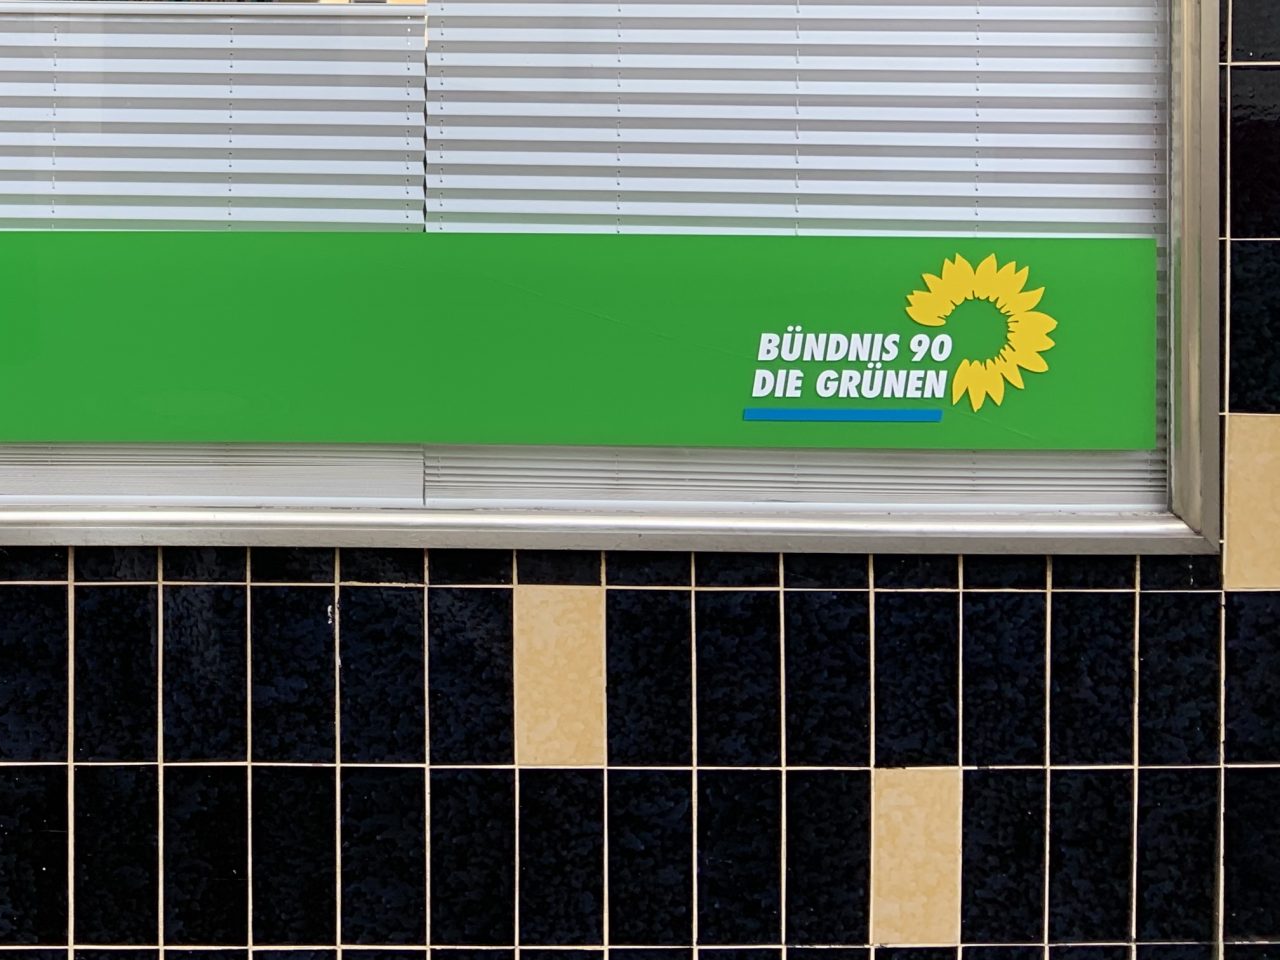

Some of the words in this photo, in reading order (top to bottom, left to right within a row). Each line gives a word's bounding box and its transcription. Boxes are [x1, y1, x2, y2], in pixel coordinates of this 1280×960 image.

[757, 325, 901, 362] BÜNDNIS
[909, 333, 954, 362] 90
[751, 368, 805, 398] DIE
[815, 362, 949, 399] GRÜNEN
